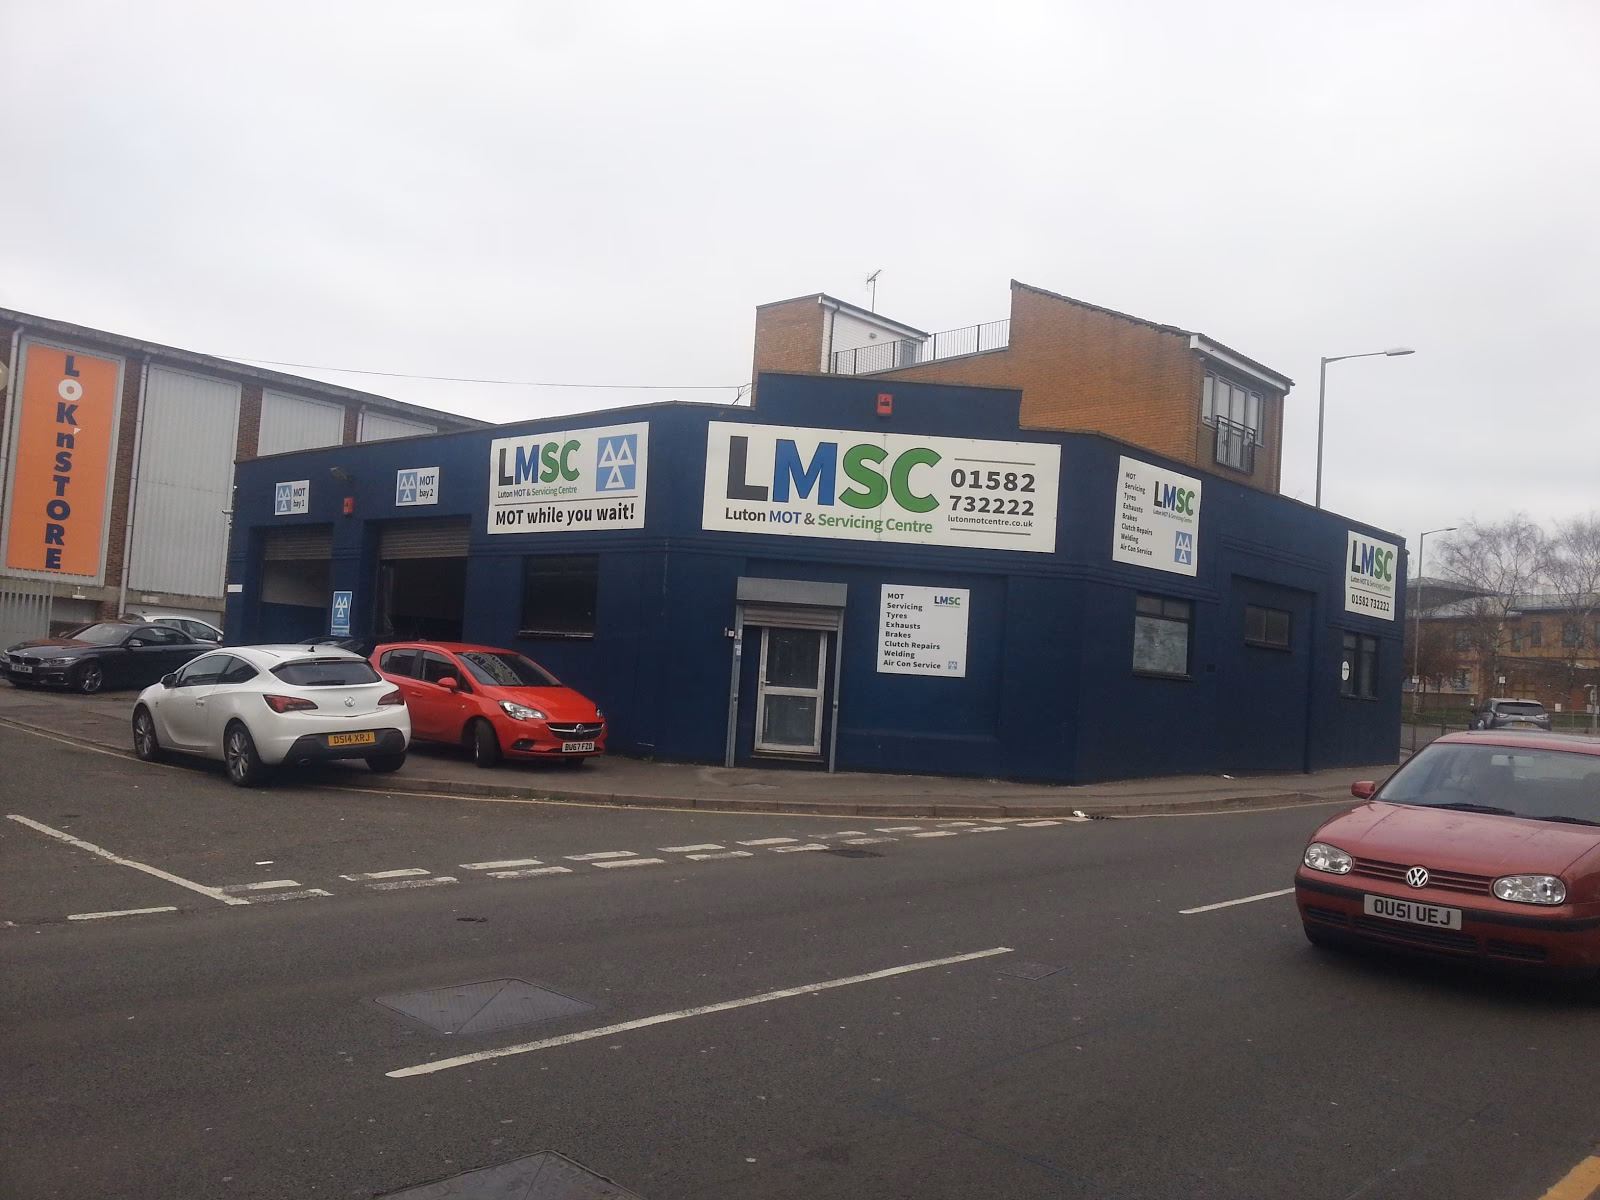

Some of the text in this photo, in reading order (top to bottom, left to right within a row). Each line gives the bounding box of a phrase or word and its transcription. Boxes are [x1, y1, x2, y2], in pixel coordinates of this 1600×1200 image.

[498, 439, 581, 486] LMSC
[726, 435, 942, 514] LMSC
[1125, 472, 1137, 480] MOT
[419, 475, 435, 486] MOT
[950, 469, 1036, 493] 01582
[293, 488, 306, 497] MOT
[419, 488, 434, 497] bay 2
[514, 489, 526, 497] MOT
[532, 487, 558, 496] Servicing
[558, 486, 578, 494] Centre
[1124, 482, 1146, 495] Servicing
[1124, 492, 1137, 502] Tyres
[1153, 481, 1195, 516] LMSC
[949, 495, 1034, 516] 732222
[1123, 502, 1144, 513] Exhausts
[496, 503, 635, 526] MOT while you wait!
[1122, 512, 1138, 522] Brakes
[725, 508, 933, 534] Luton MOT & Servicing Centre
[948, 515, 1033, 528] lutonmotcentre.co.uk
[1121, 523, 1153, 536] Clutch Repairs
[1120, 533, 1139, 544] Welding
[1137, 547, 1152, 556] Service
[1351, 540, 1393, 582] LMSC
[934, 596, 961, 605] LMSC
[1352, 594, 1389, 611] 01582 732222
[887, 602, 923, 612] Servicing
[886, 612, 908, 620] Tyres
[885, 640, 940, 650] Clutch Repairs
[884, 650, 915, 659] Welding
[334, 733, 370, 744] DS14 XRJ
[565, 743, 580, 751] BU67
[1374, 899, 1450, 925] OU51 UEJ
